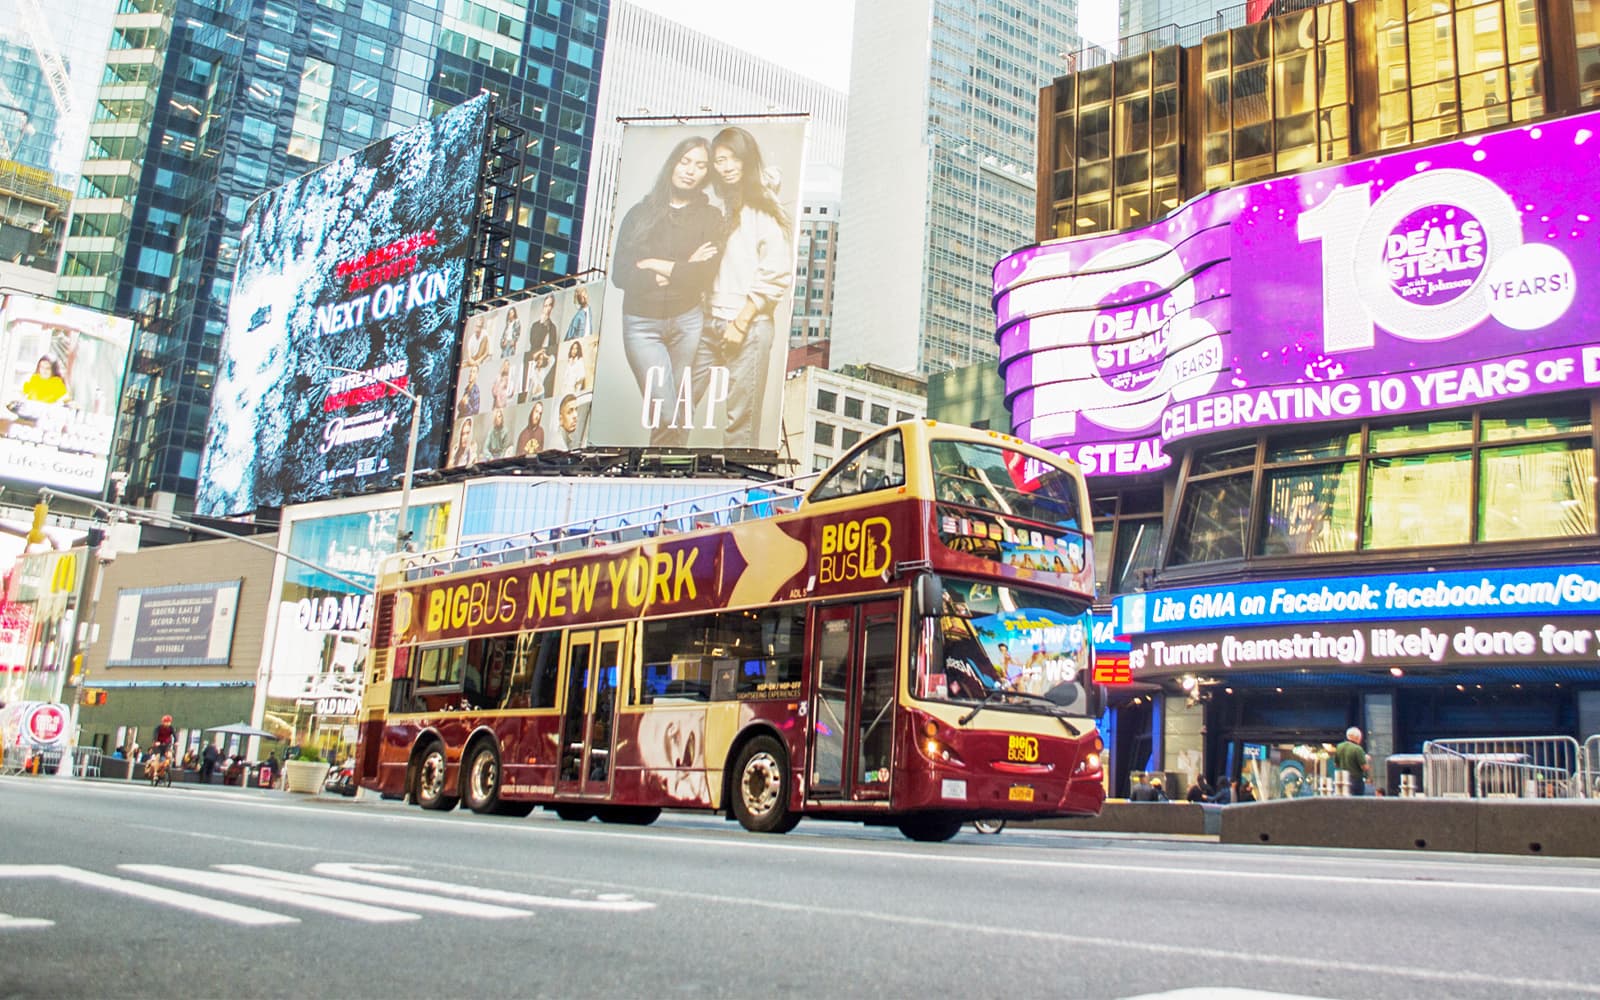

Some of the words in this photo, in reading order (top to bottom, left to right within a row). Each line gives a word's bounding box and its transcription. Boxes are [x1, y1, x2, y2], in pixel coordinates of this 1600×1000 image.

[1387, 220, 1484, 259] DEALS
[1299, 168, 1523, 353] 10
[1389, 245, 1485, 281] STEALS
[314, 295, 370, 338] NEXT
[371, 283, 406, 320] OF
[406, 268, 451, 311] KIN
[1400, 284, 1426, 298] Tory
[1427, 278, 1473, 297] Johnson
[1489, 272, 1569, 301] YEARS!
[1094, 297, 1177, 341] DEALS
[330, 359, 409, 394] STREAMING
[1175, 346, 1219, 380] YEARS!
[641, 366, 730, 429] GAP
[1161, 383, 1361, 439] CELEBRATING
[1369, 378, 1407, 412] 10
[1411, 359, 1529, 406] YEARS
[1536, 358, 1575, 385] OF
[53, 462, 95, 479] Good
[821, 521, 861, 555] BIG
[527, 562, 600, 619] NEW
[608, 547, 700, 610] YORK
[819, 552, 858, 584] BUS
[297, 596, 338, 631] OLD
[1152, 597, 1186, 623] Like
[1189, 591, 1236, 621] GMA
[1240, 596, 1264, 610] on
[1270, 583, 1381, 615] Facebook:
[1151, 640, 1218, 666] Turner
[1222, 629, 1365, 668] (hamstring)
[1370, 626, 1449, 662] likely
[1453, 625, 1536, 655] done
[1540, 624, 1592, 655] for
[316, 698, 336, 714] OLD
[1007, 748, 1025, 761] BUS
[1008, 735, 1025, 748] BIG
